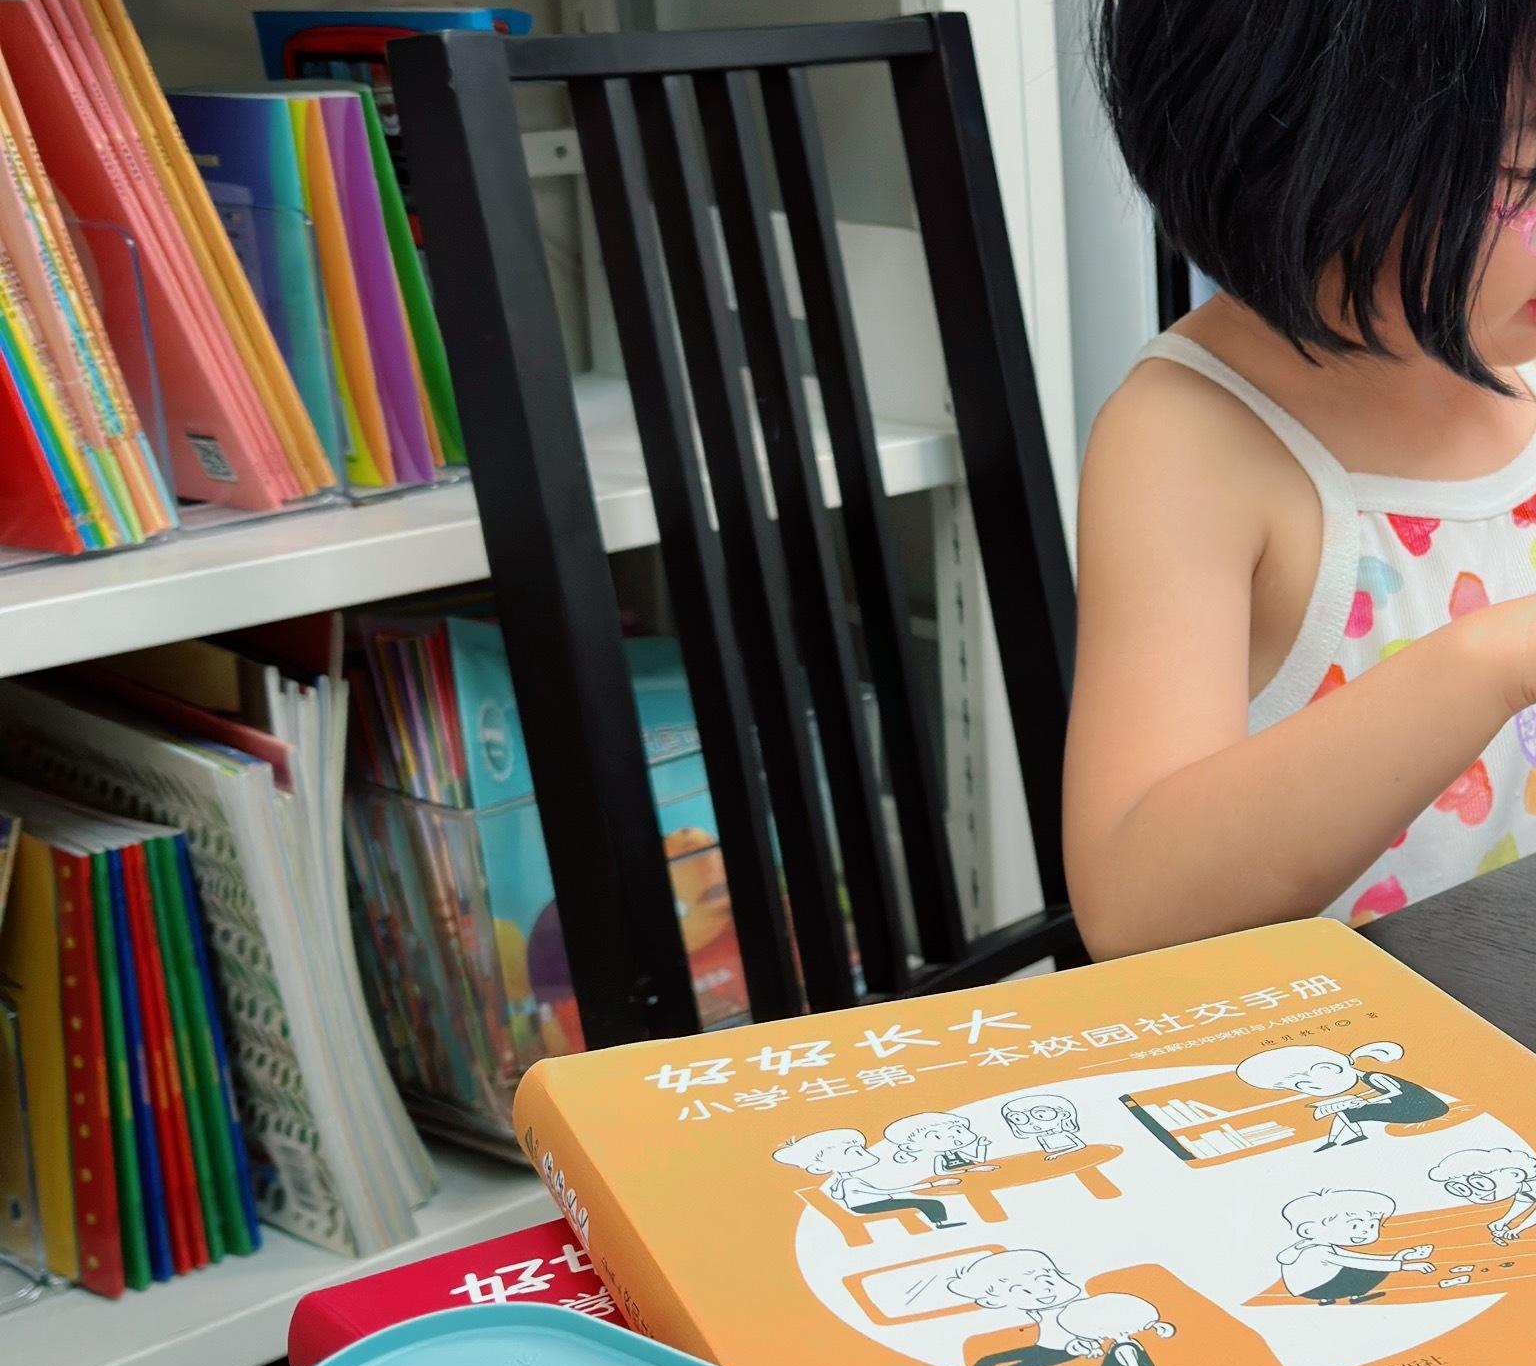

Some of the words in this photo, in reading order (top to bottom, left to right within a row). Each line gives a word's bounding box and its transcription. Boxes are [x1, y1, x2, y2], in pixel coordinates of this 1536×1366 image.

[645, 1007, 1033, 1095] 好好长大
[677, 973, 1344, 1124] 小学生第一本校园社交手册
